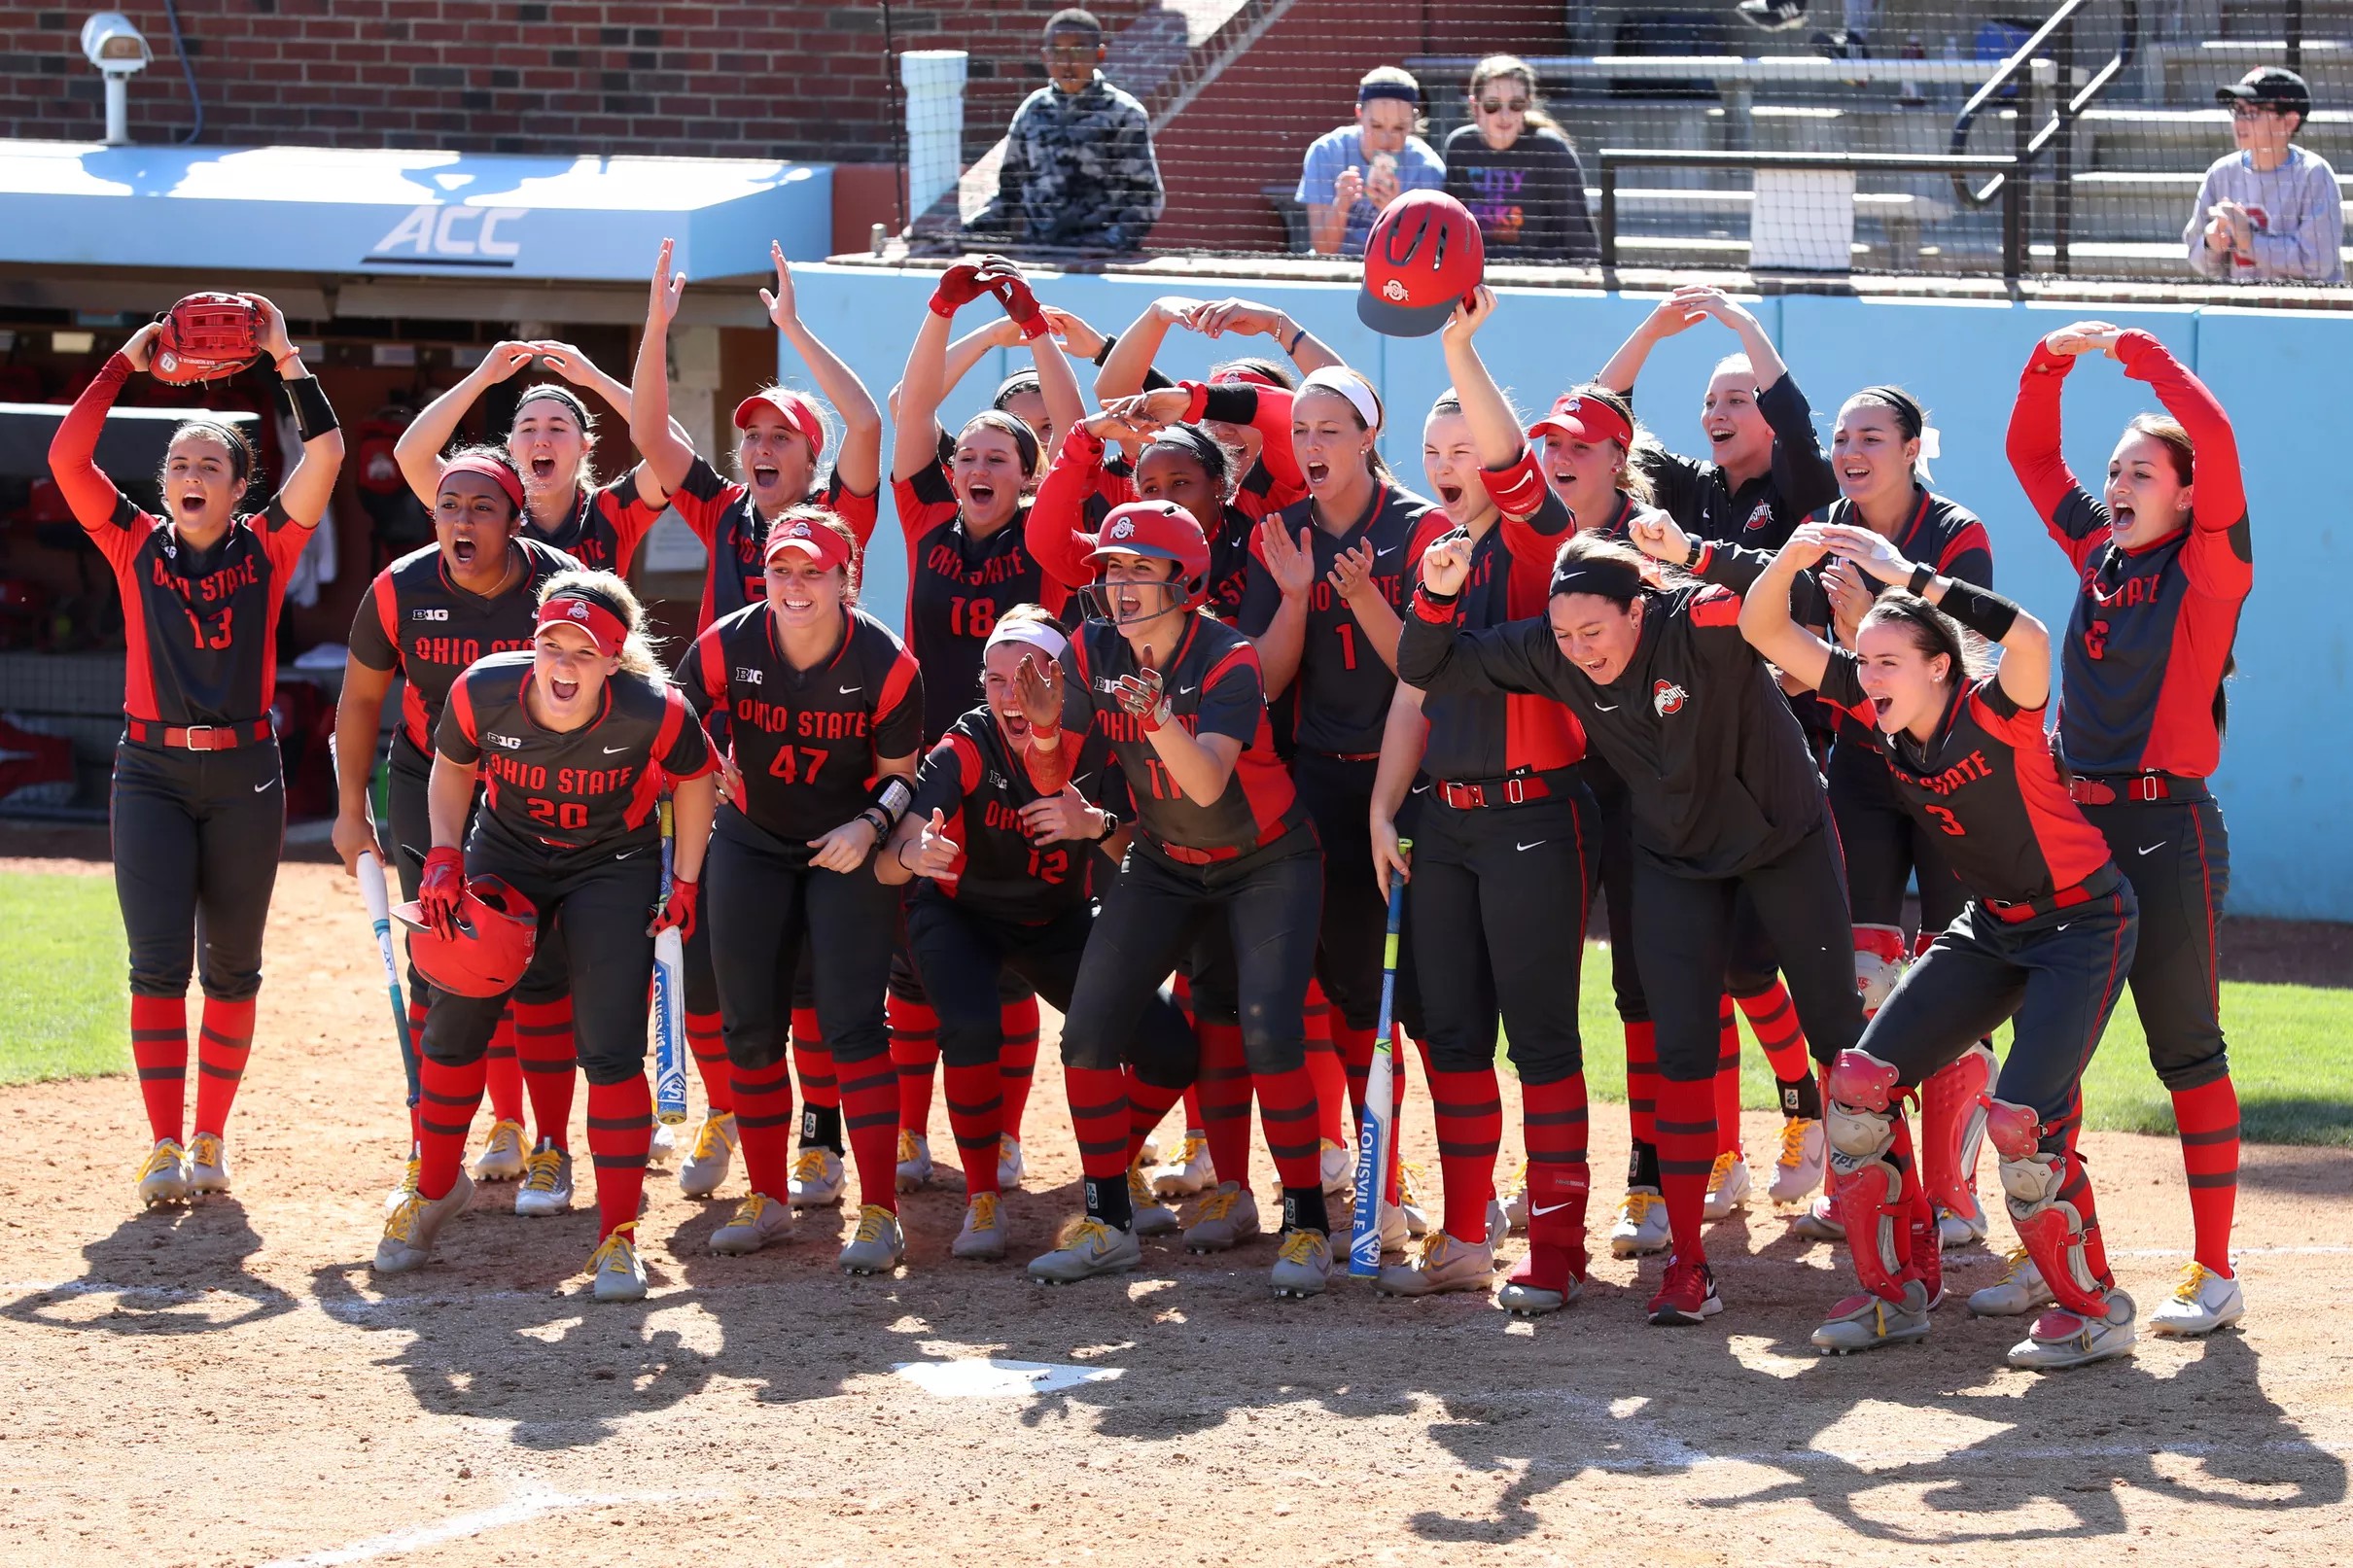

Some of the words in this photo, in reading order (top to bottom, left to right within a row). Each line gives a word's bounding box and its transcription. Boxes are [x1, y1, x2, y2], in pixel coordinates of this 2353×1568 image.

[372, 205, 530, 256] ACC
[184, 607, 232, 650] 13
[949, 596, 996, 638] 18
[415, 637, 479, 666] OHIO
[1335, 623, 1357, 670] 1
[738, 698, 788, 733] OHIO
[797, 711, 866, 739] STATE
[489, 753, 546, 790] OHIO
[557, 766, 633, 795] STATE
[769, 745, 829, 785] 47
[526, 797, 588, 830] 20
[1925, 804, 1966, 836] 3
[1027, 847, 1069, 885] 12
[1352, 1121, 1375, 1231] LOUISVILLE
